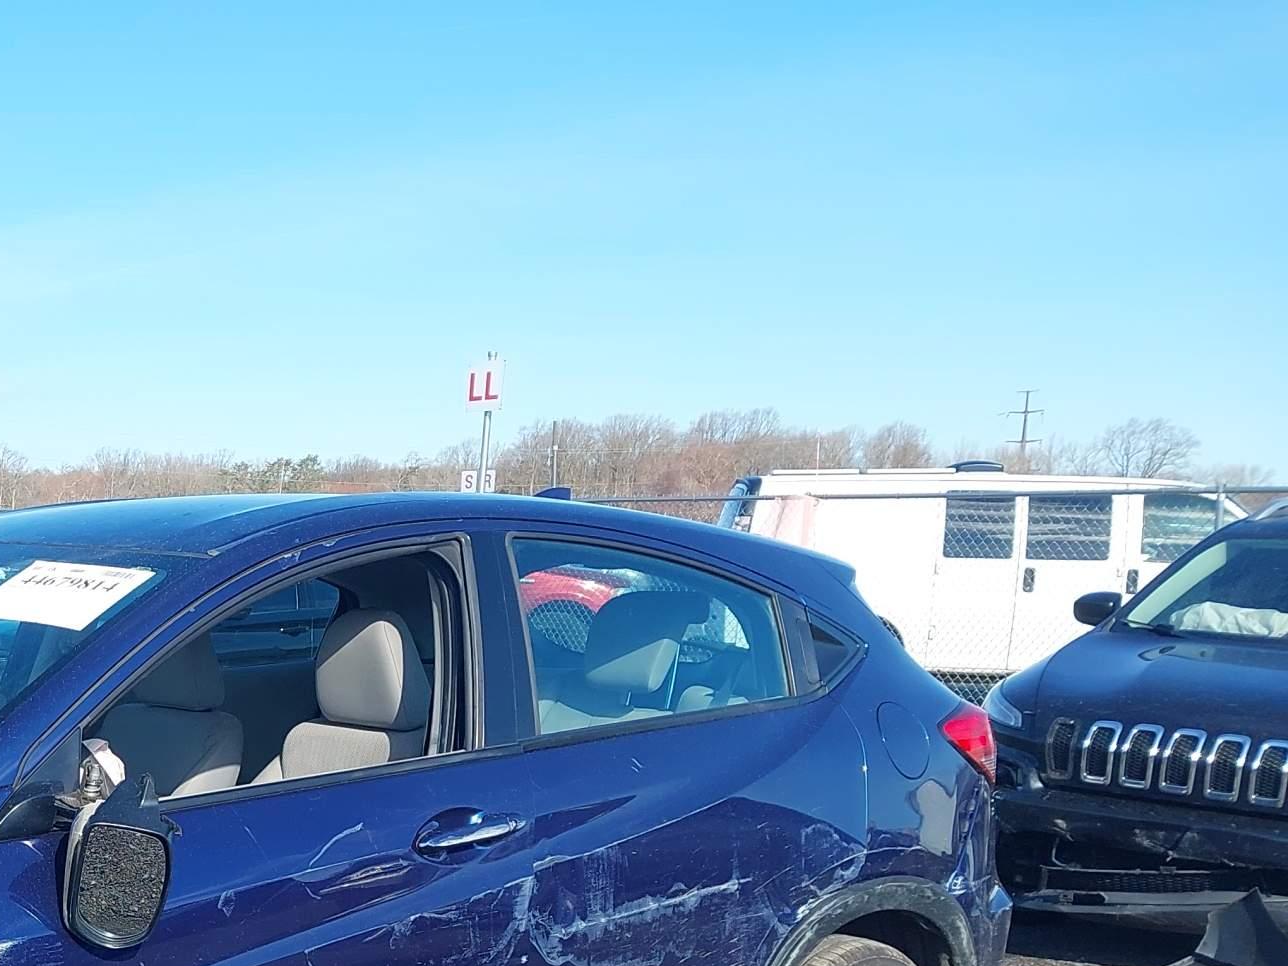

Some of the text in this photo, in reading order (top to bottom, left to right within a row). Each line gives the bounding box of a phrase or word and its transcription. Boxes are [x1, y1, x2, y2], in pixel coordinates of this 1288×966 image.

[468, 371, 499, 402] LL
[465, 474, 473, 489] S
[484, 473, 492, 489] R
[22, 574, 120, 593] 44679814
